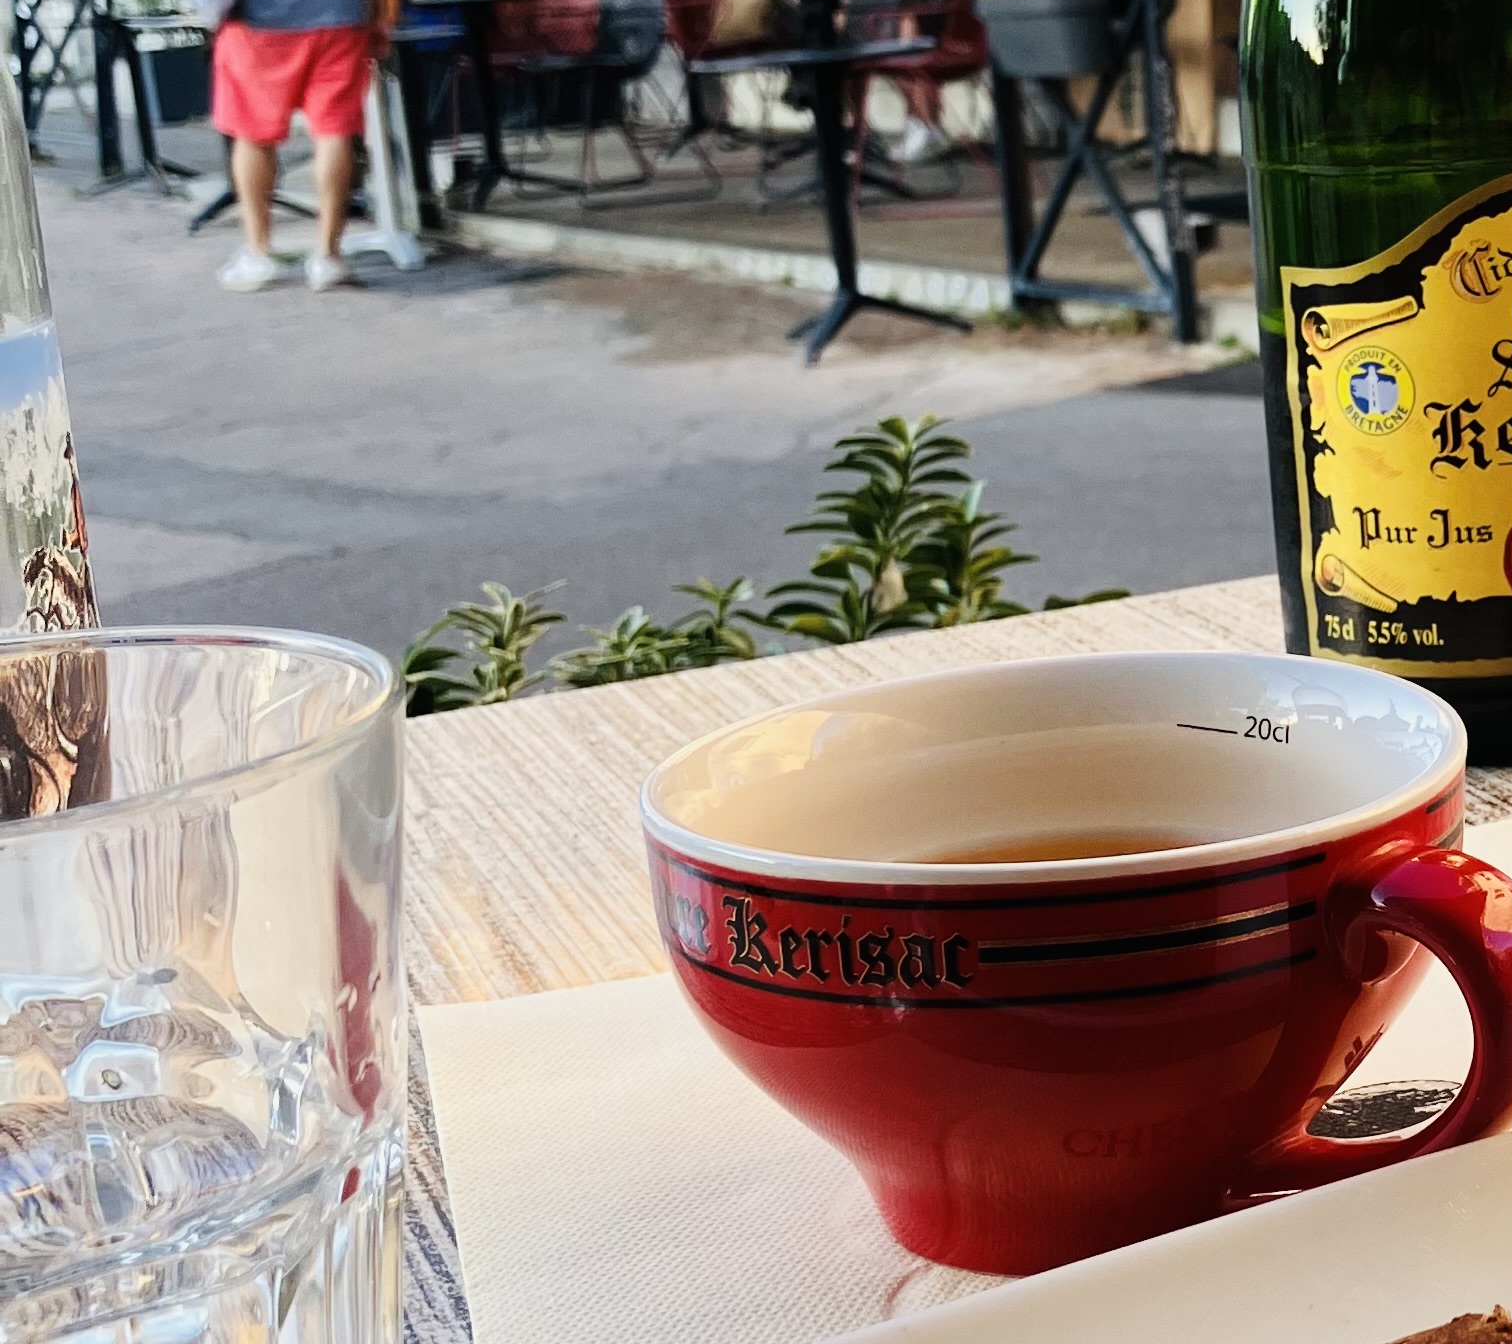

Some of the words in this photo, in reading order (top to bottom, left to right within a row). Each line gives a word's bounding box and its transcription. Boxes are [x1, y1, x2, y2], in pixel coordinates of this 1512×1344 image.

[1344, 350, 1387, 372] PRODUIT
[1389, 358, 1402, 373] EN
[1345, 404, 1408, 433] BRETAGNE
[1352, 506, 1418, 550] Pur
[1427, 508, 1494, 549] Jus
[1413, 623, 1445, 646] vol.
[1243, 715, 1290, 744] 20cl
[721, 894, 975, 990] Kerisac
